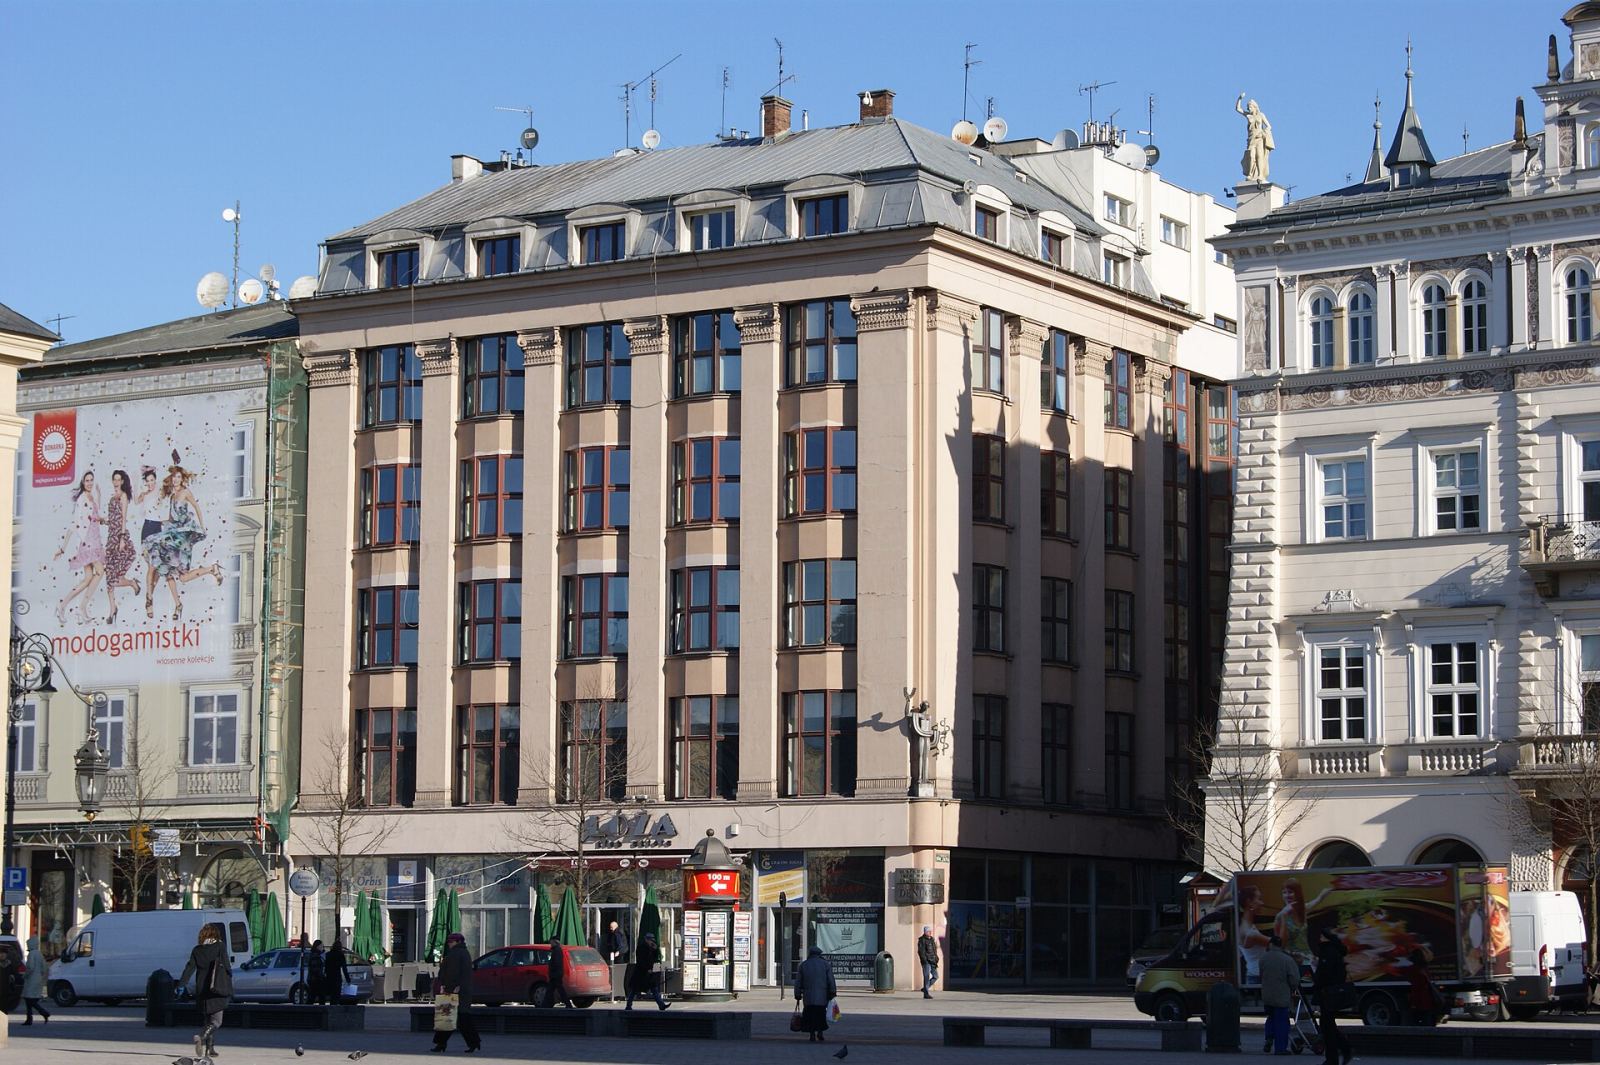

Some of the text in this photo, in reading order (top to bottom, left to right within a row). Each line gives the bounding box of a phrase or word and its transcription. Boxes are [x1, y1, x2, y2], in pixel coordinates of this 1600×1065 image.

[52, 623, 201, 657] modogamistki
[187, 654, 215, 664] kolekcje
[9, 869, 22, 888] P
[356, 875, 383, 886] Orbis
[707, 873, 722, 881] 100
